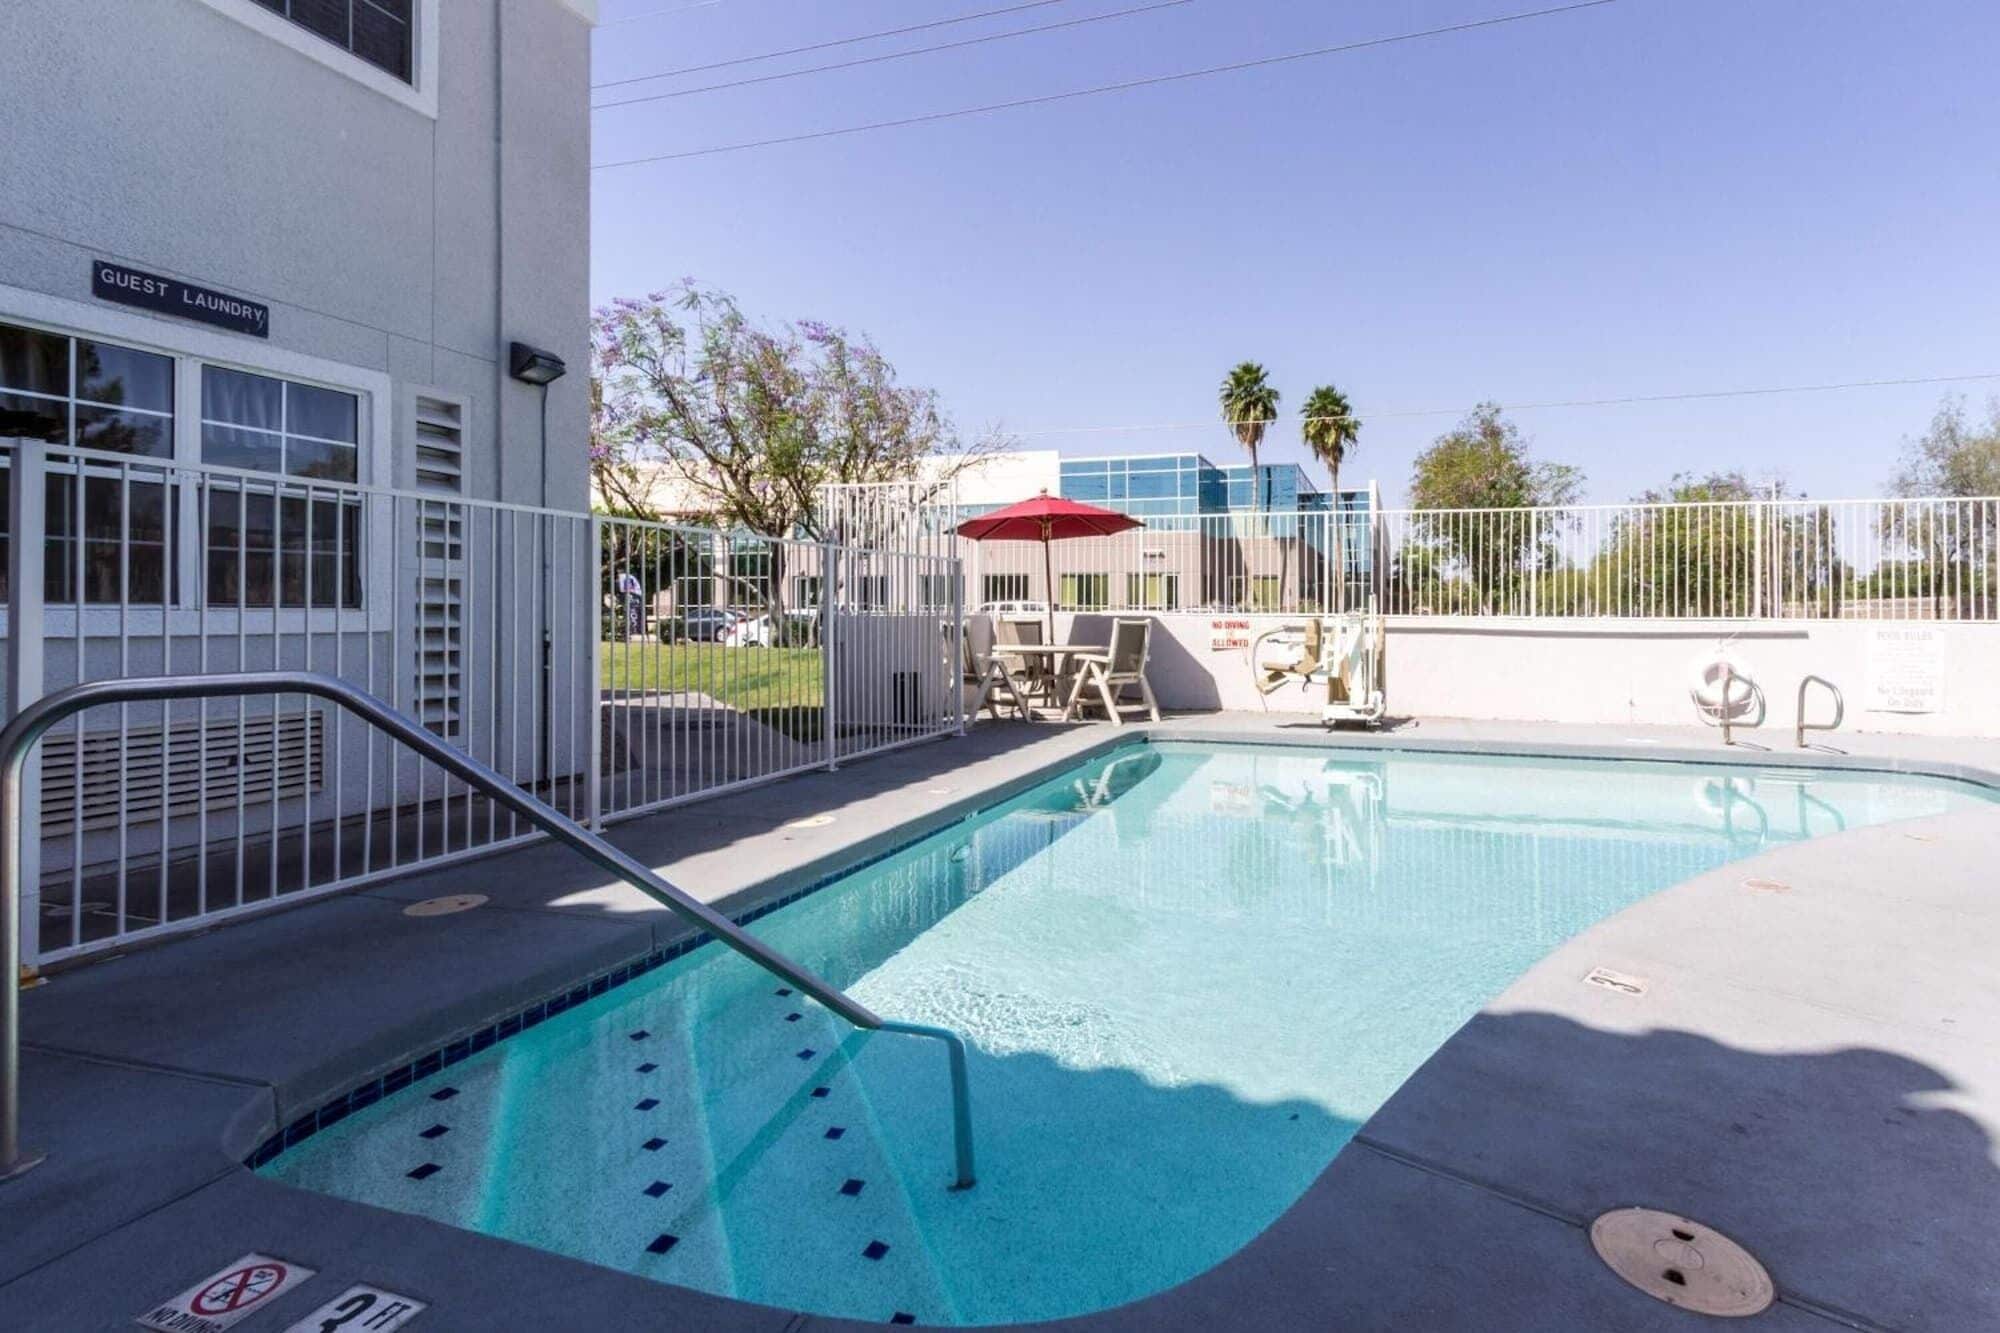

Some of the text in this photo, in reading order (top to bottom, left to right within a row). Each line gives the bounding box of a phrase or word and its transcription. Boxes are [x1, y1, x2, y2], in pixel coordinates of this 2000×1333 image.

[101, 268, 264, 322] GUEST LAUNDRY
[1212, 621, 1250, 629] NO DIVING
[1212, 639, 1249, 648] ALLOWED
[147, 1307, 179, 1323] NO
[362, 1302, 412, 1330] FT
